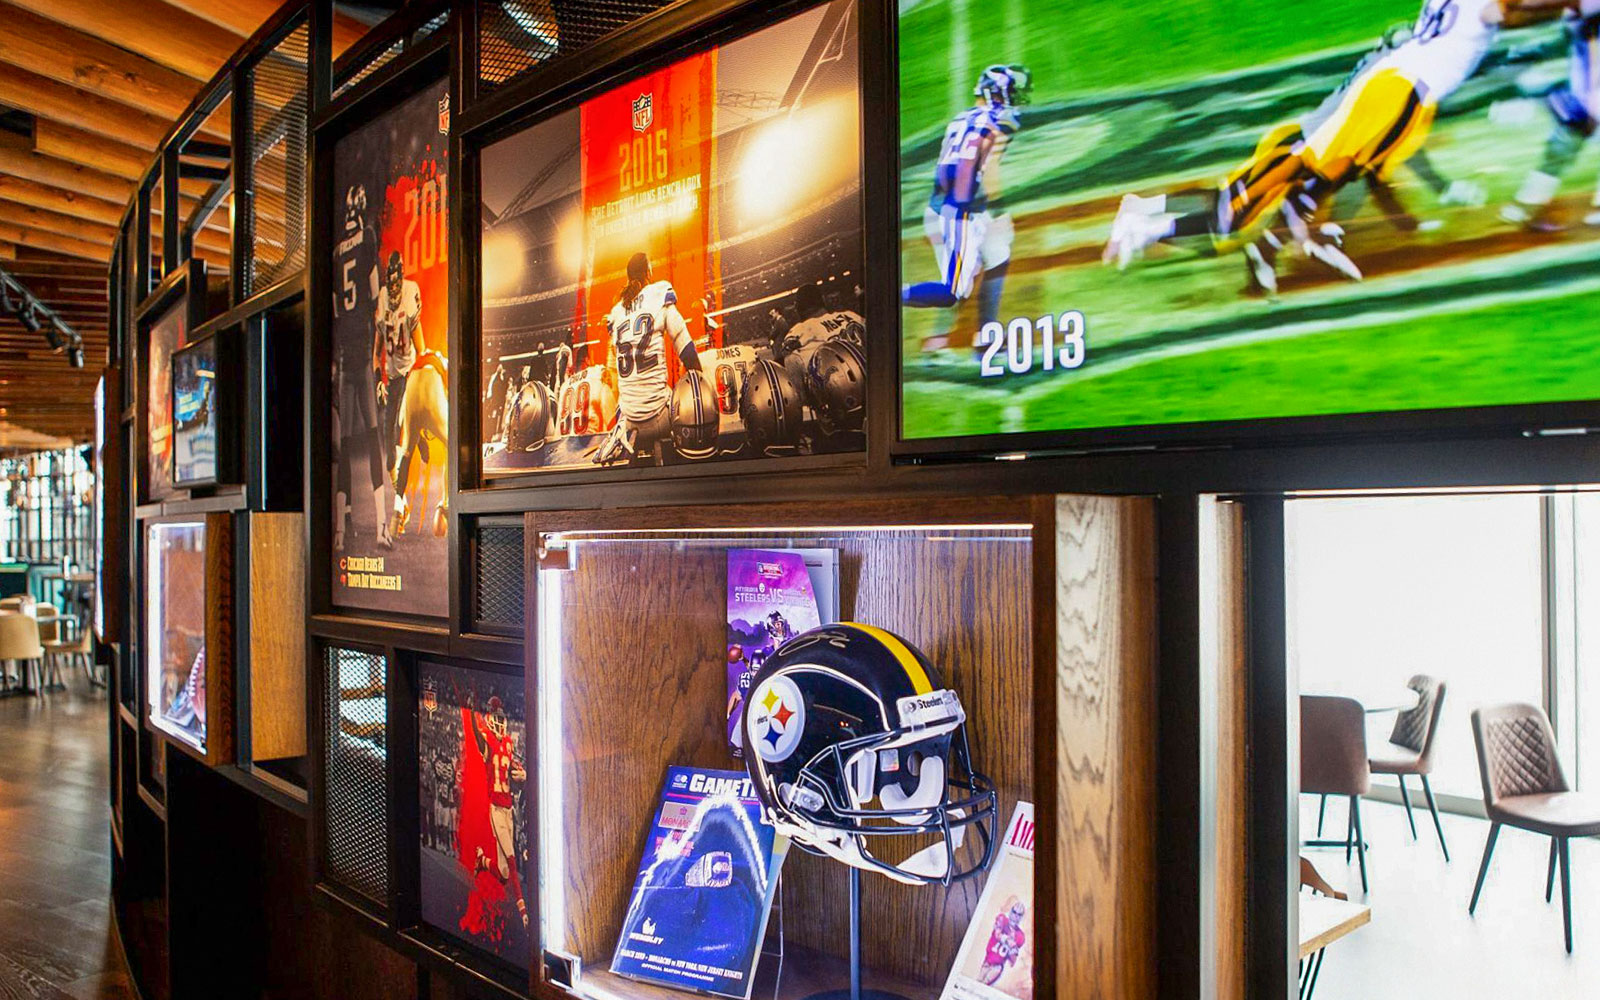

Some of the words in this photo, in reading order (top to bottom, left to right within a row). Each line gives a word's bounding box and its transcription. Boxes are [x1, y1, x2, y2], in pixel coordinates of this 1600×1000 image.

[619, 128, 668, 192] 2015
[635, 189, 656, 208] LIONS
[657, 180, 681, 202] BENCH
[682, 173, 701, 192] LOOK
[343, 258, 357, 311] 5
[616, 313, 659, 379] 52
[980, 310, 1085, 377] 2013
[560, 382, 591, 435] 99
[735, 592, 770, 603] STEELERS
[917, 696, 944, 709] Steelers
[629, 932, 664, 945] WEMBLEY
[641, 962, 662, 972] OFFICIAL
[663, 966, 681, 975] MATCH
[681, 970, 714, 982] PROGRAMME
